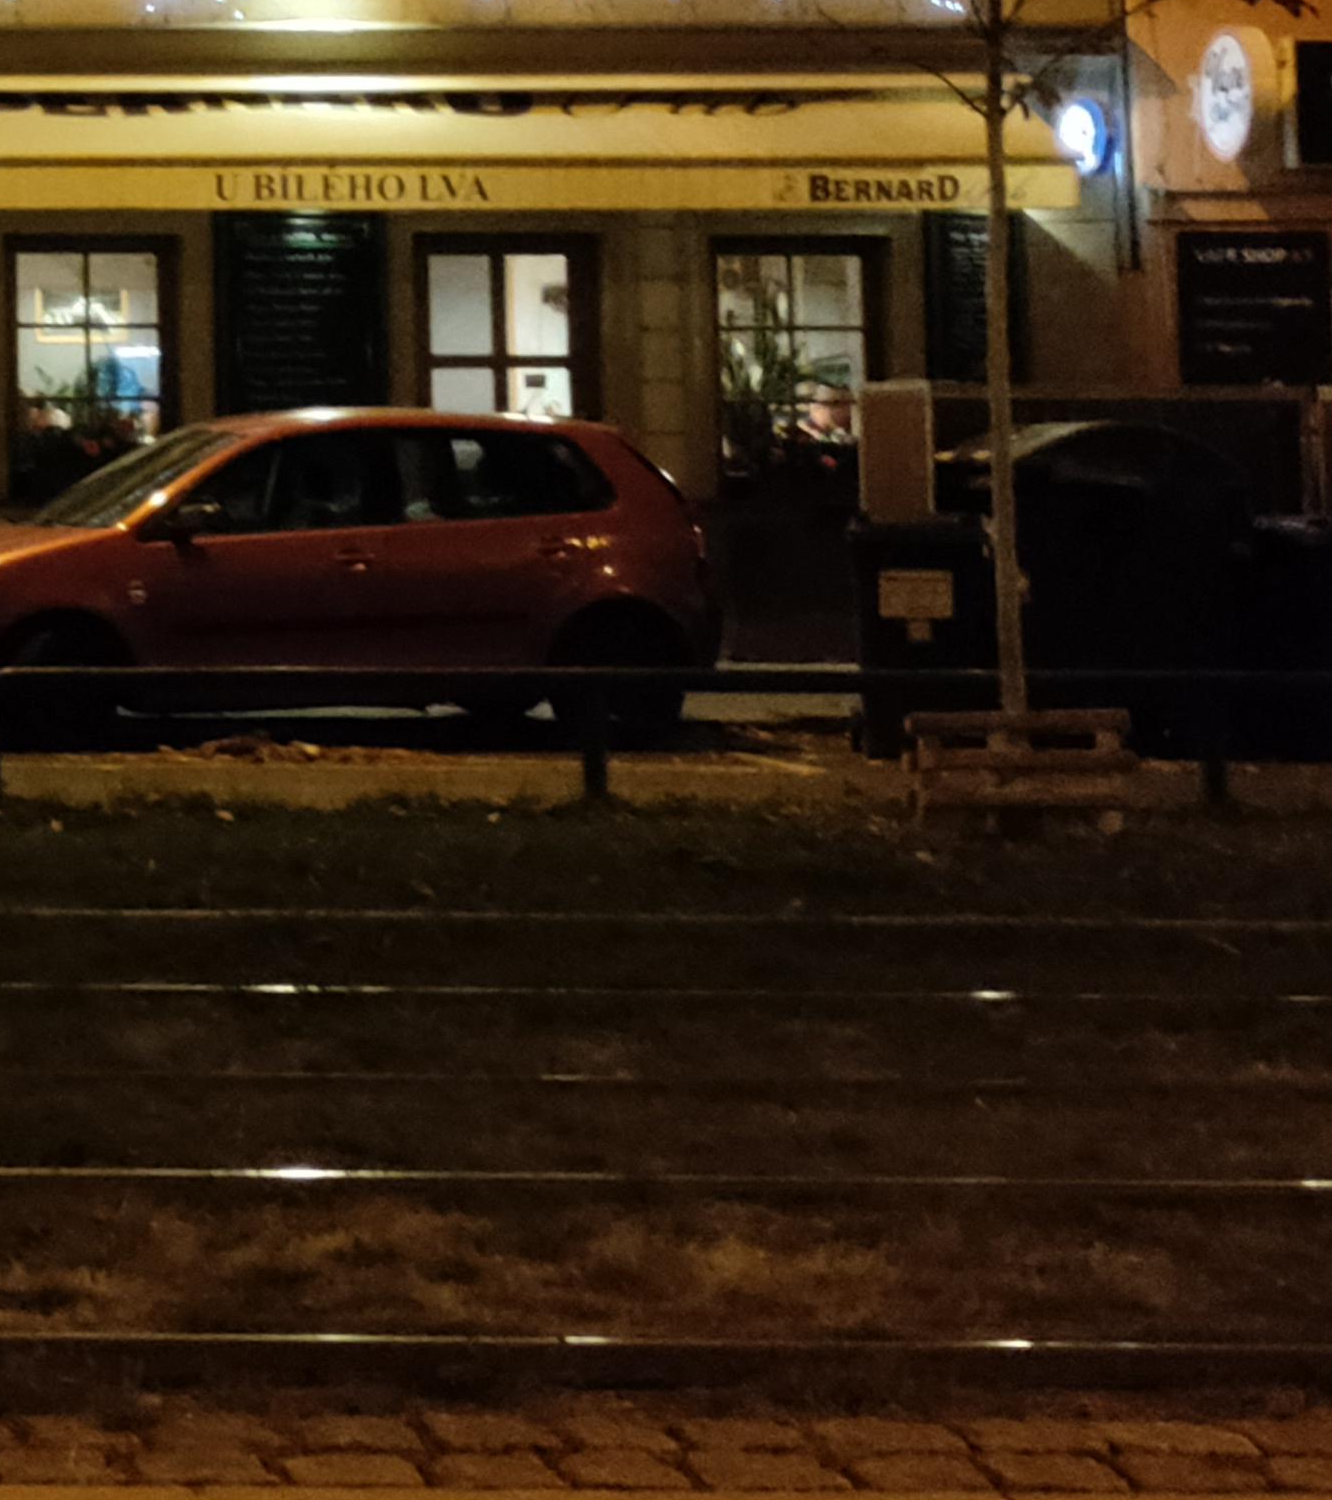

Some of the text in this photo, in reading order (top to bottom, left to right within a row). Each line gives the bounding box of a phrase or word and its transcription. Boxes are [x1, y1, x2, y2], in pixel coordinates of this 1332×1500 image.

[214, 173, 239, 202] U
[419, 173, 490, 202] LVA
[808, 174, 960, 203] BERNARD
